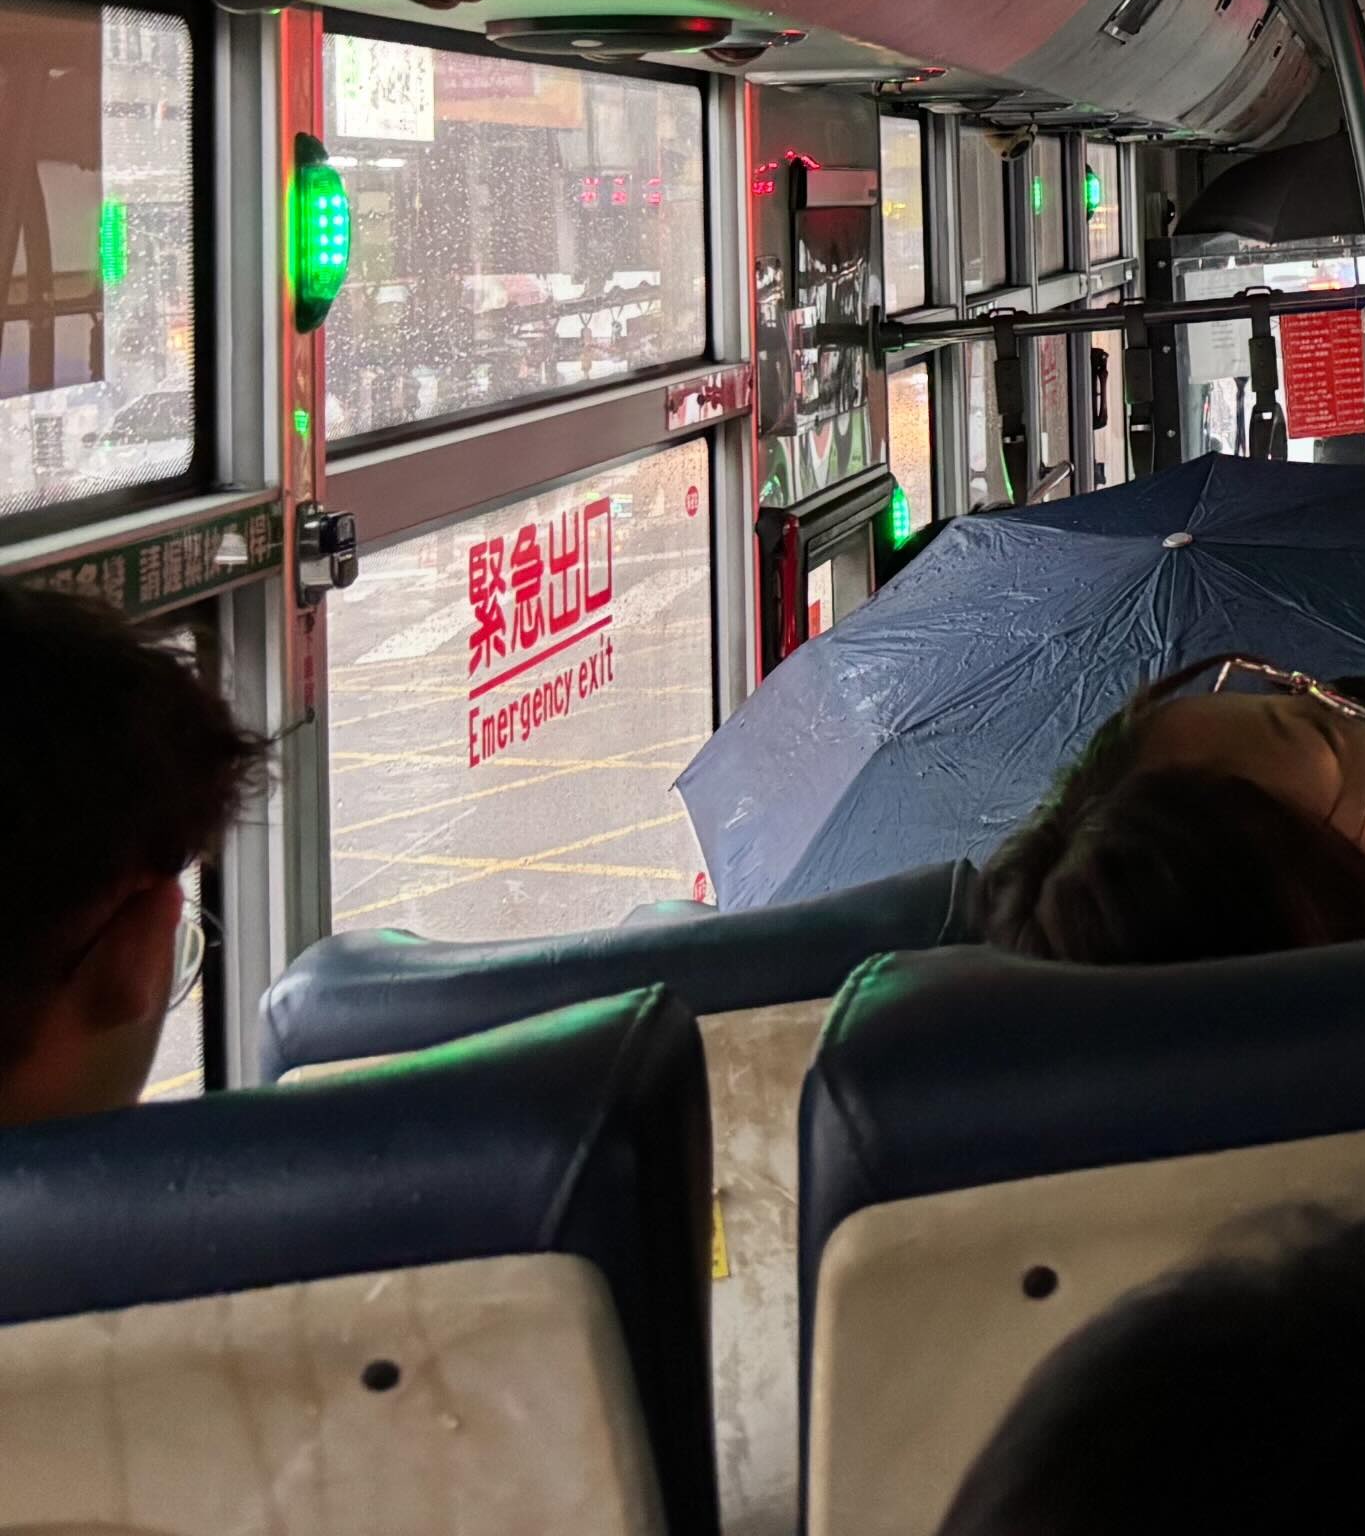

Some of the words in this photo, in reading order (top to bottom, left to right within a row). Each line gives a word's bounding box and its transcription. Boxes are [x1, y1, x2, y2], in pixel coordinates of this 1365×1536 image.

[468, 496, 613, 677] 緊急出口
[468, 666, 574, 768] Emergency
[577, 633, 614, 698] exit
